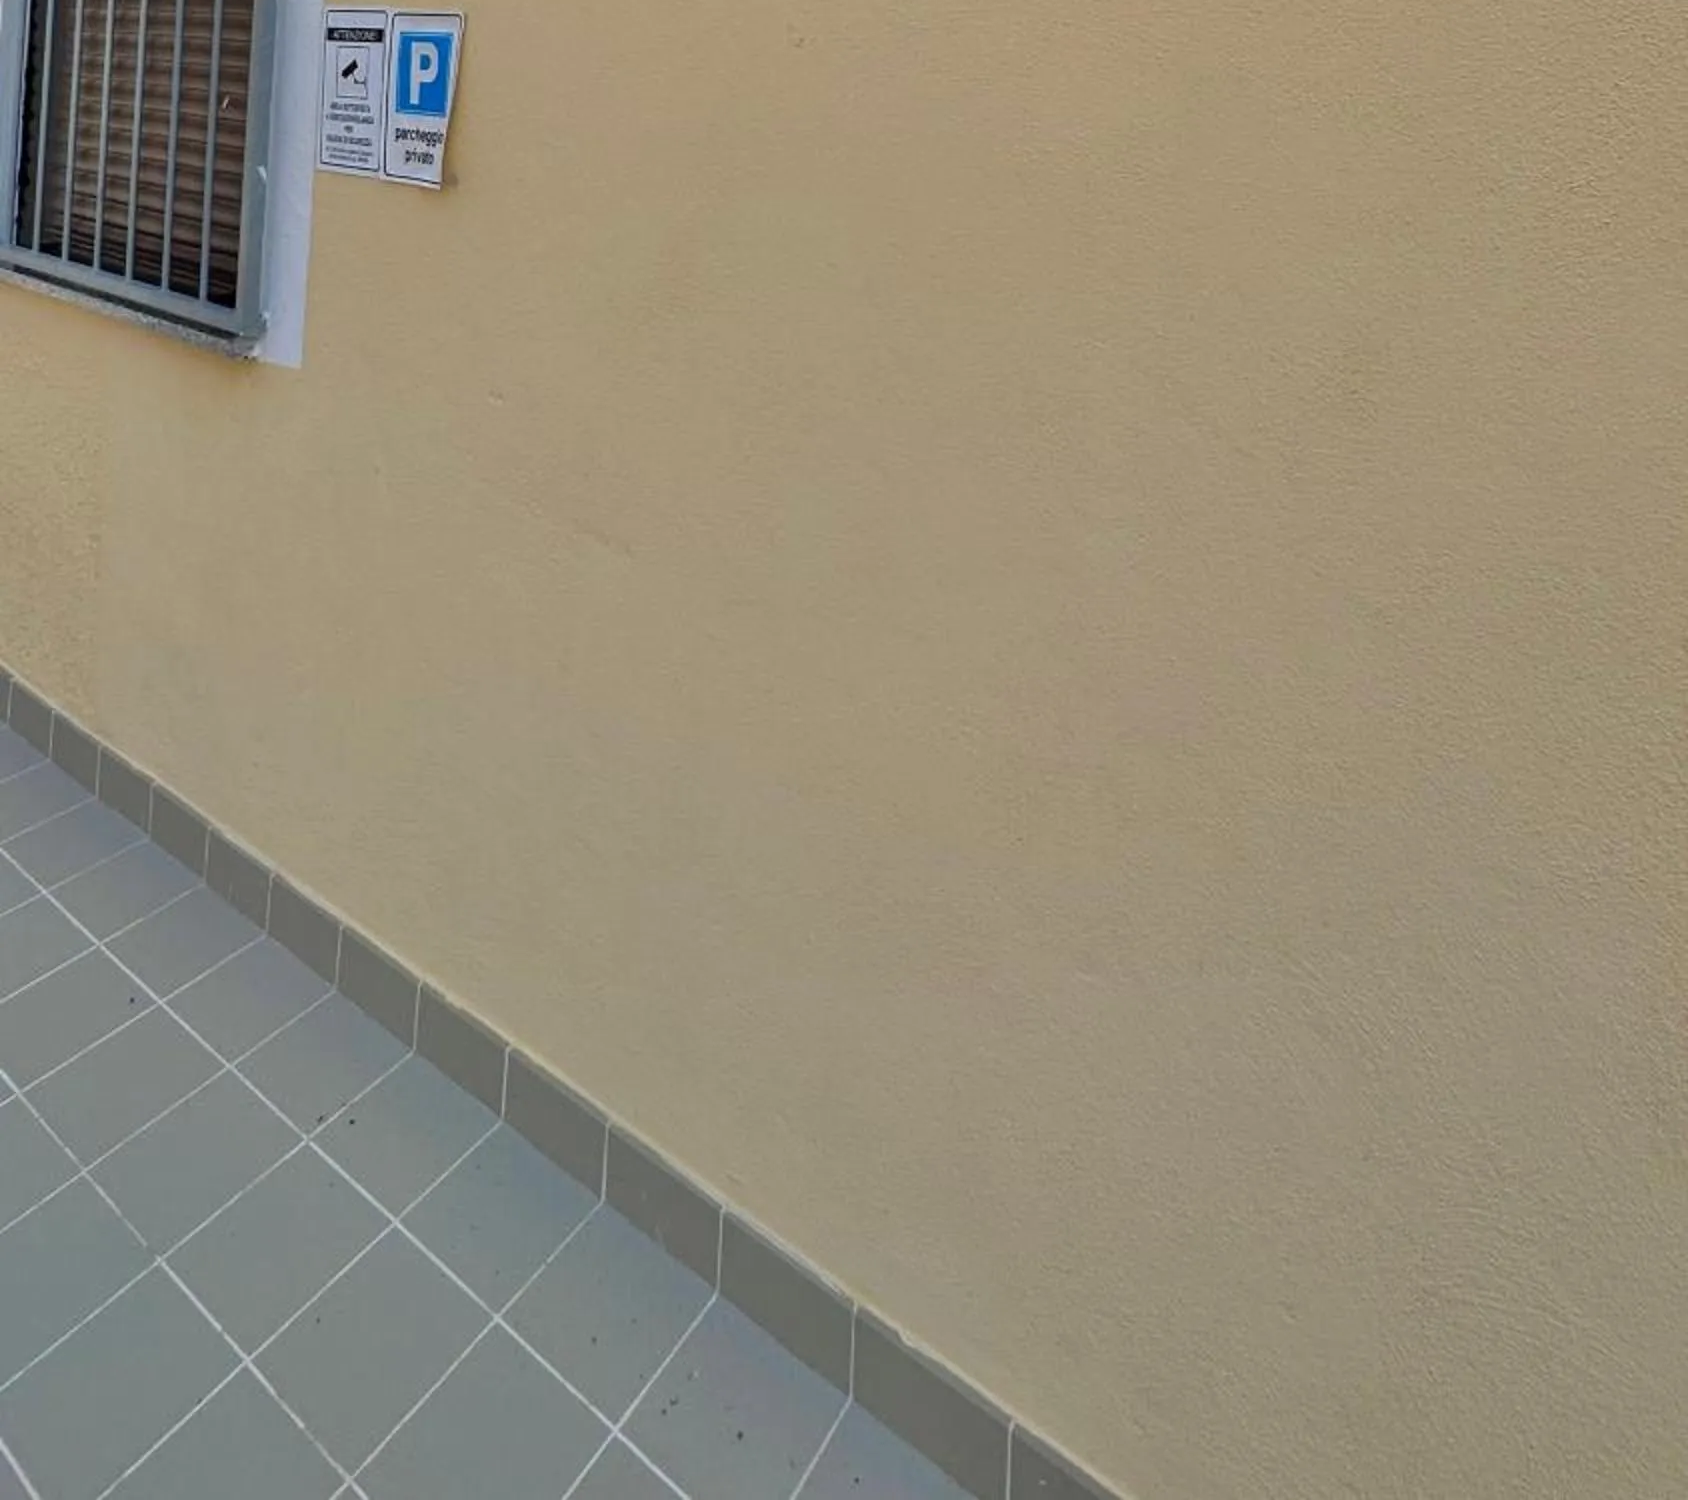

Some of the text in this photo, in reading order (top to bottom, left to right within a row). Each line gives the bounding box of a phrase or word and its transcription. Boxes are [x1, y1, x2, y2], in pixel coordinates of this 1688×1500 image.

[409, 41, 439, 105] P
[394, 127, 444, 147] parcheggio
[404, 147, 435, 165] privato
